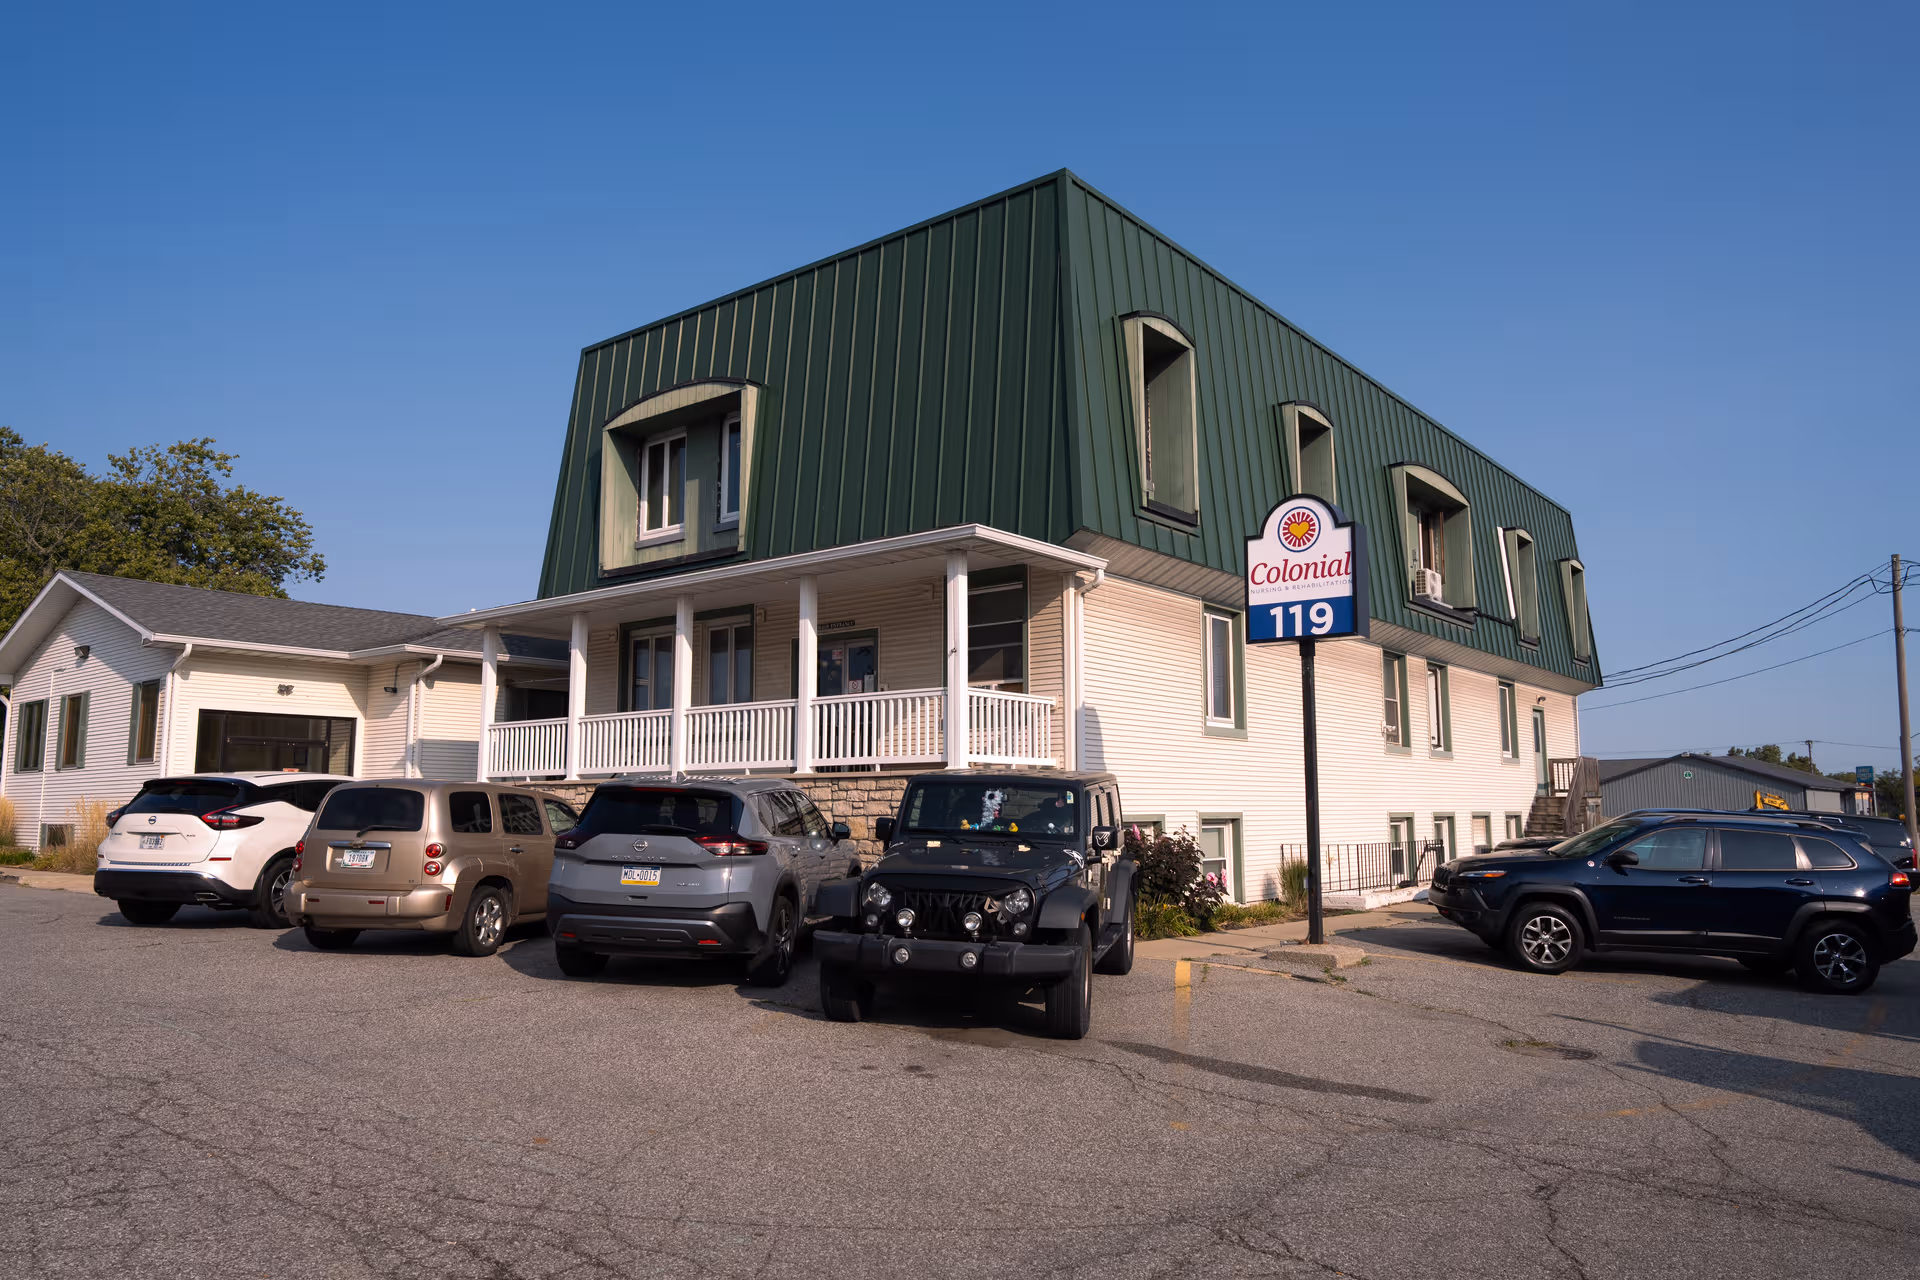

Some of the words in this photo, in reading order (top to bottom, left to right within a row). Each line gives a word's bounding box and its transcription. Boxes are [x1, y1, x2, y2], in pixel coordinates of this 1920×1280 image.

[1250, 551, 1352, 586] Colonial
[1250, 586, 1282, 594] NURSING
[1292, 579, 1353, 591] REHABILITATION
[1269, 601, 1334, 638] 119
